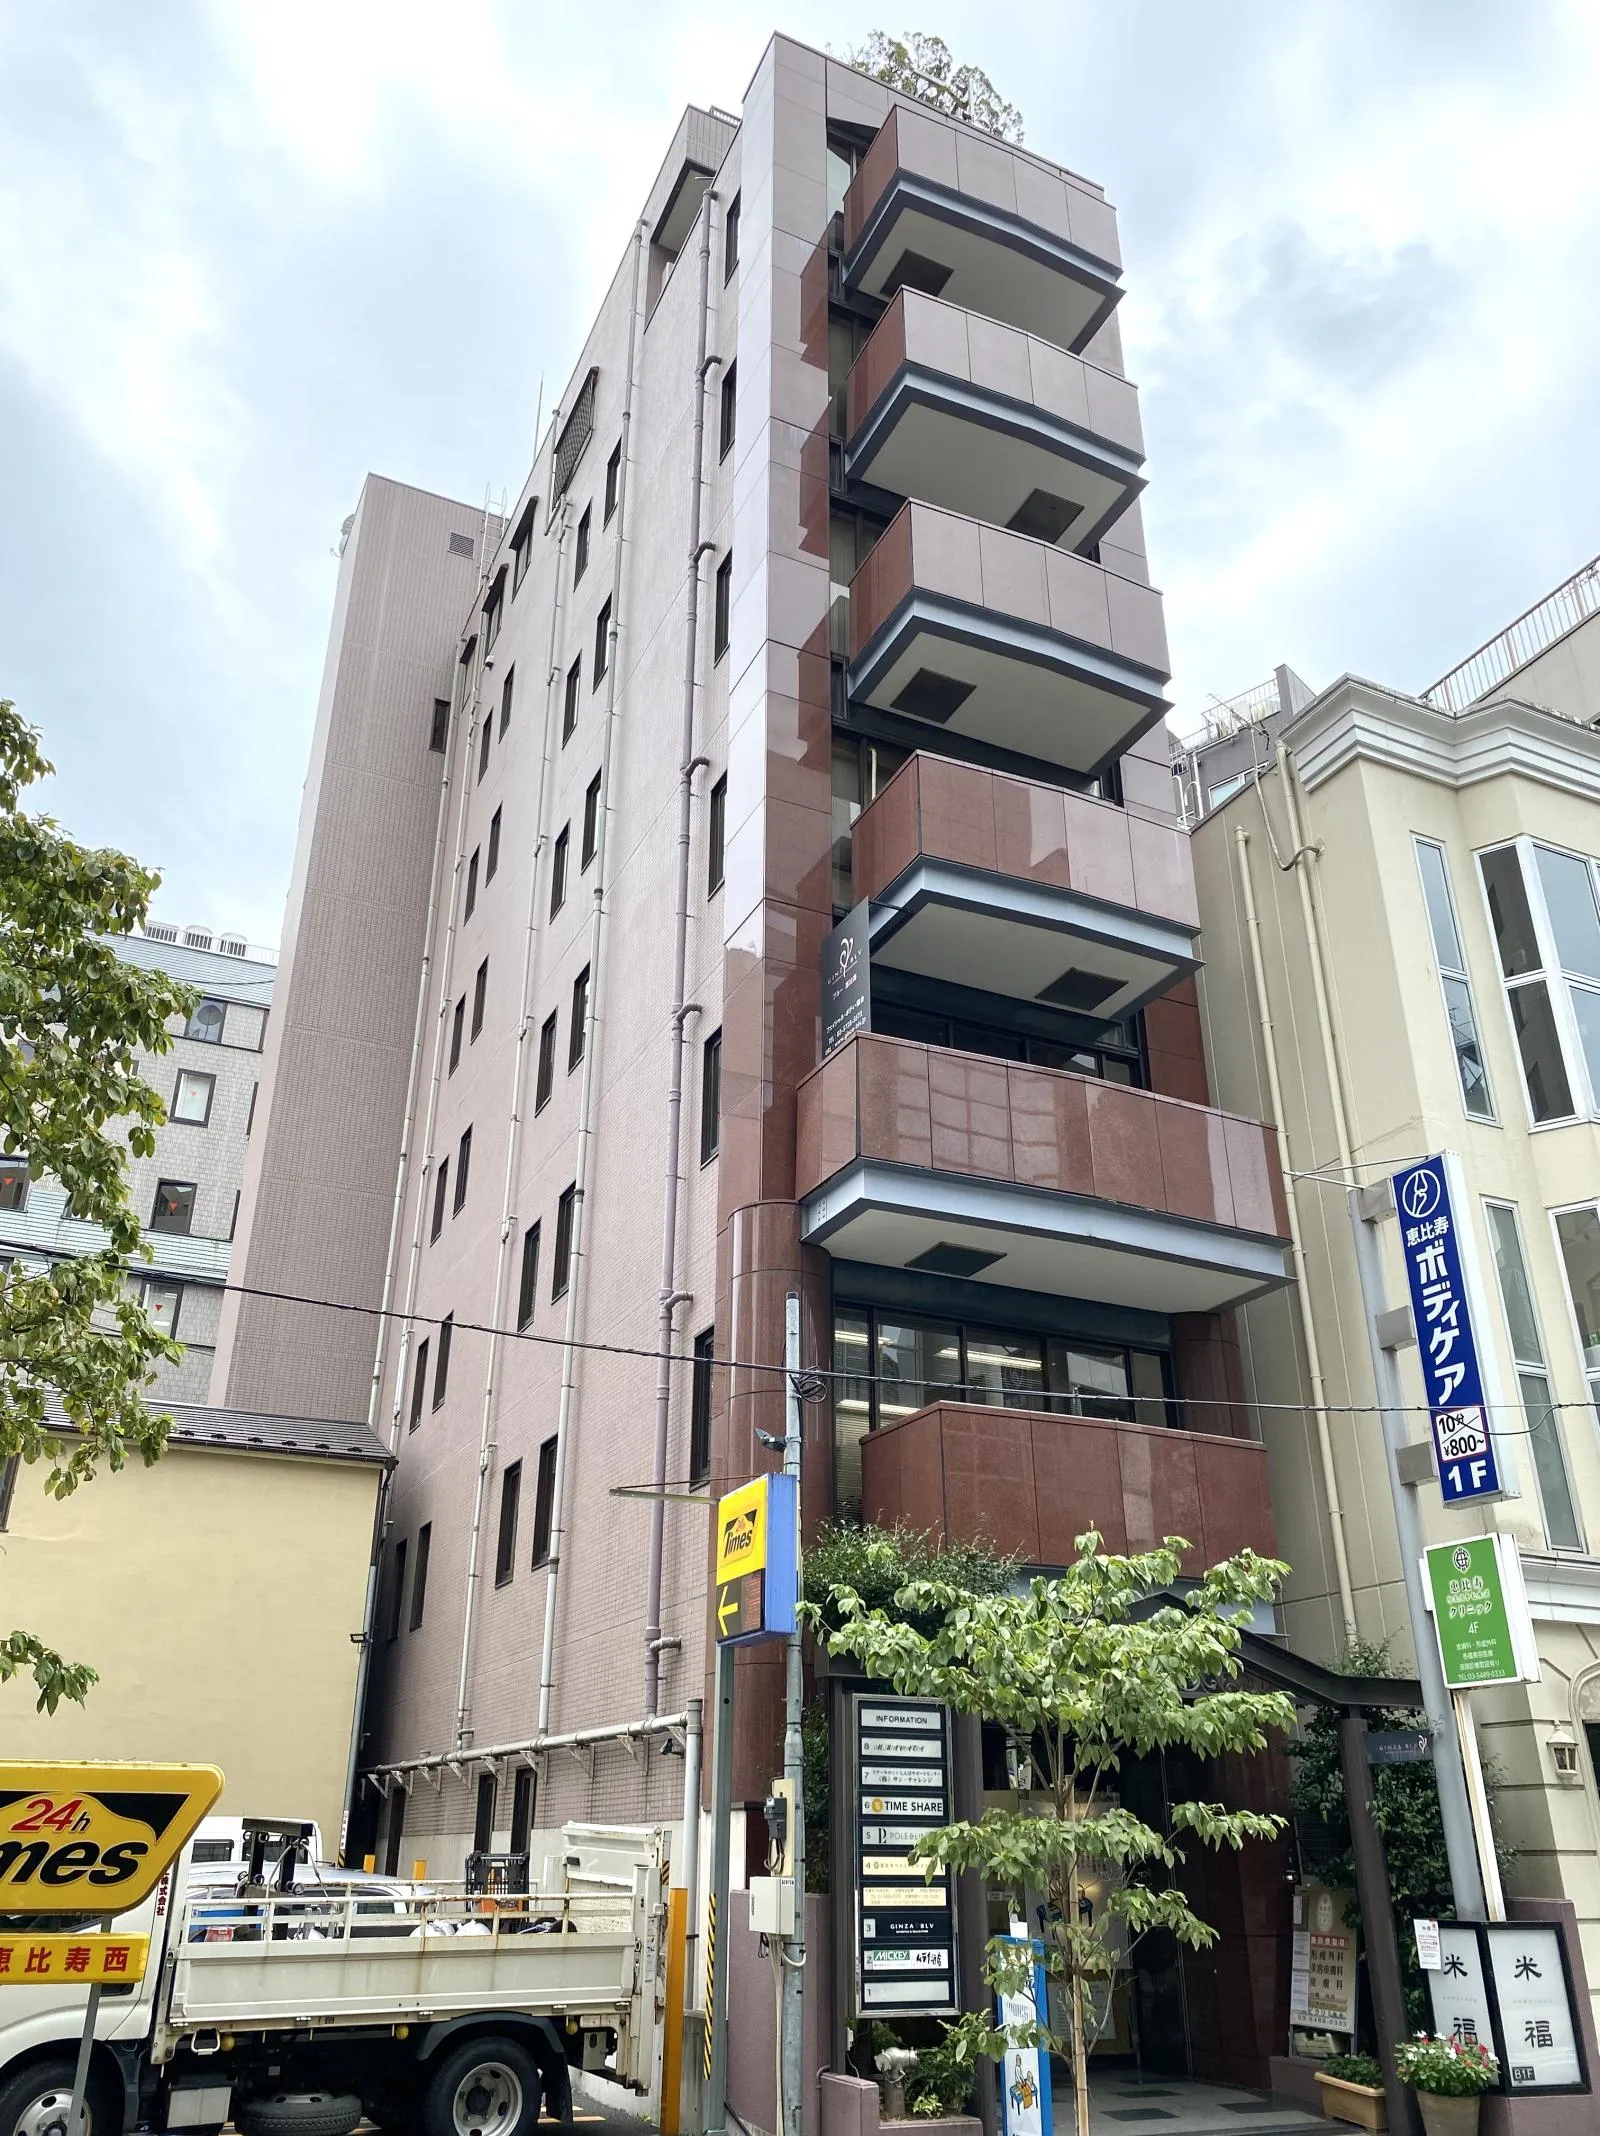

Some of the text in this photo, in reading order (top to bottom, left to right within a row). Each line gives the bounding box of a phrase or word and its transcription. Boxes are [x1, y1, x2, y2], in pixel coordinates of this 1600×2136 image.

[1406, 1215, 1450, 1248] 恵比寿
[1416, 1239, 1464, 1405] ボディケア
[1447, 1459, 1488, 1493] 1F
[724, 1528, 753, 1560] Times
[1449, 1601, 1492, 1619] クリニック
[1469, 1622, 1479, 1634] 4F
[876, 1715, 928, 1725] INFORMATION
[863, 1742, 870, 1750] 8
[864, 1771, 870, 1779] 7
[864, 1801, 943, 1813] 6 TIME SHARE
[9, 1798, 91, 1833] 24h
[156, 1872, 170, 1917] 株式会社
[866, 1923, 872, 1932] 3
[866, 1956, 873, 1965] 2
[874, 1951, 908, 1961] MICKEY
[867, 1989, 872, 1997] 1
[1513, 2068, 1534, 2081] B1F
